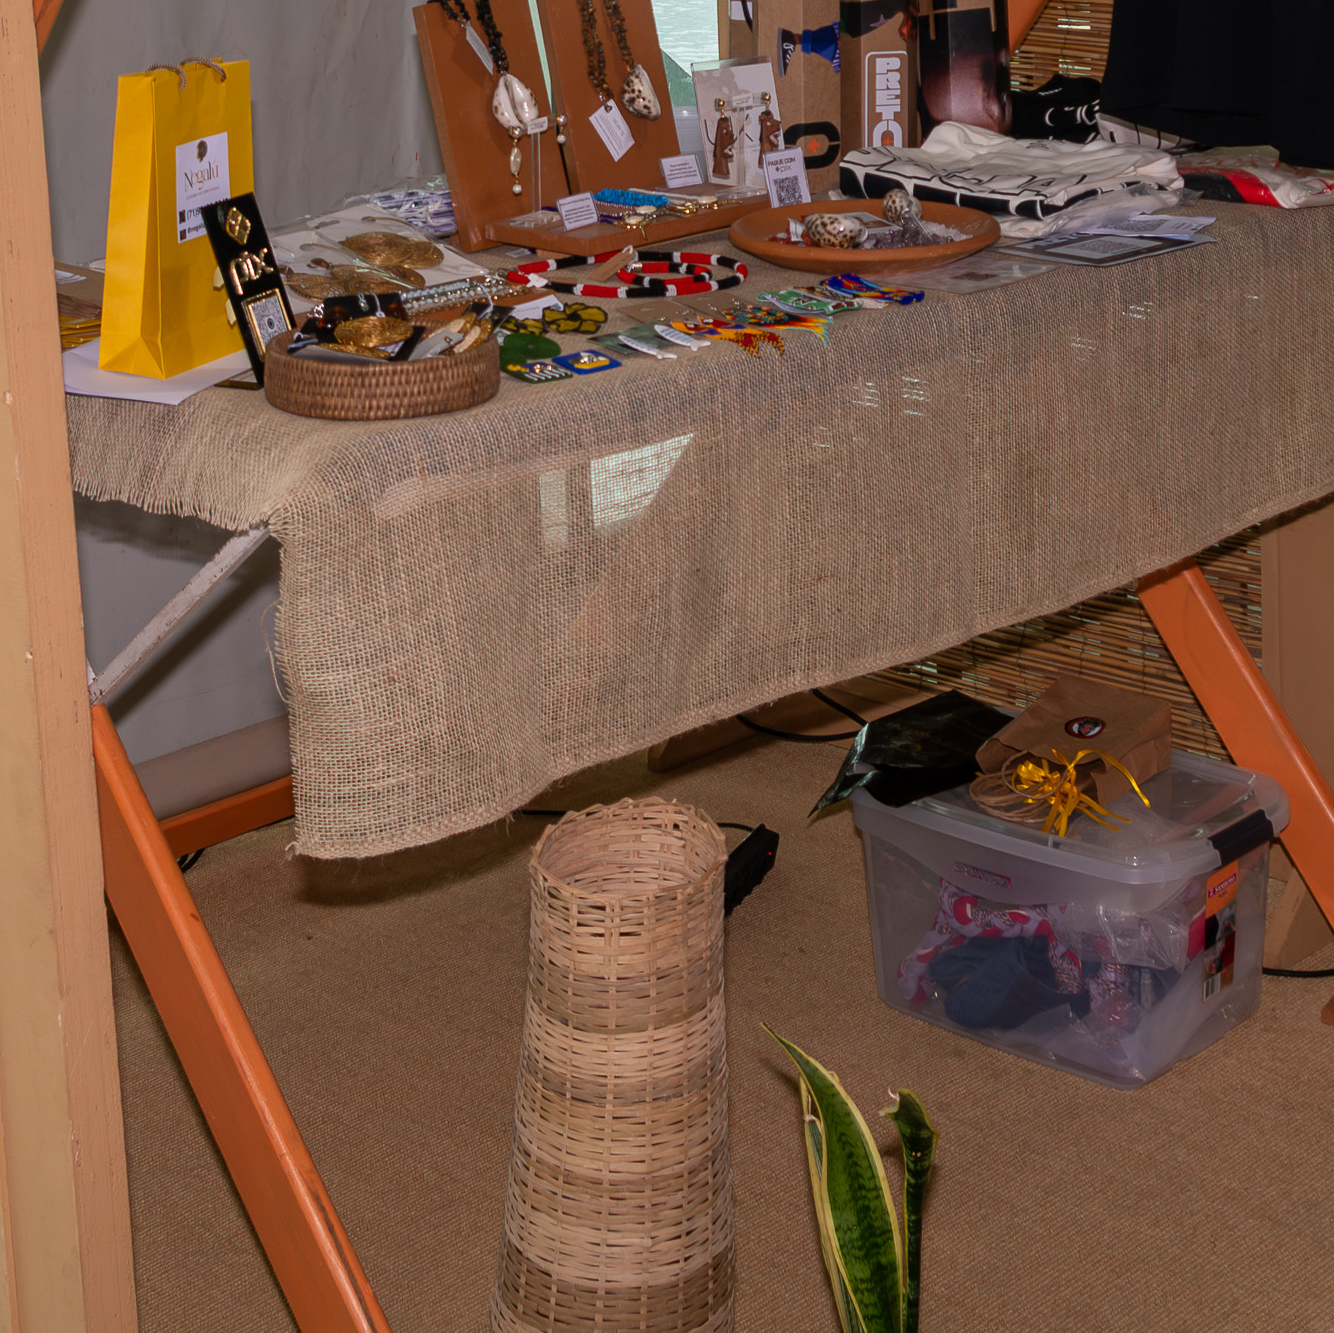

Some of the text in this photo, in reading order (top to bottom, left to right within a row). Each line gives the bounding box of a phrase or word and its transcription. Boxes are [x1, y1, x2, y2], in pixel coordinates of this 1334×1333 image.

[872, 57, 903, 148] PRETO
[185, 159, 219, 192] Negalú
[229, 248, 274, 296] pix
